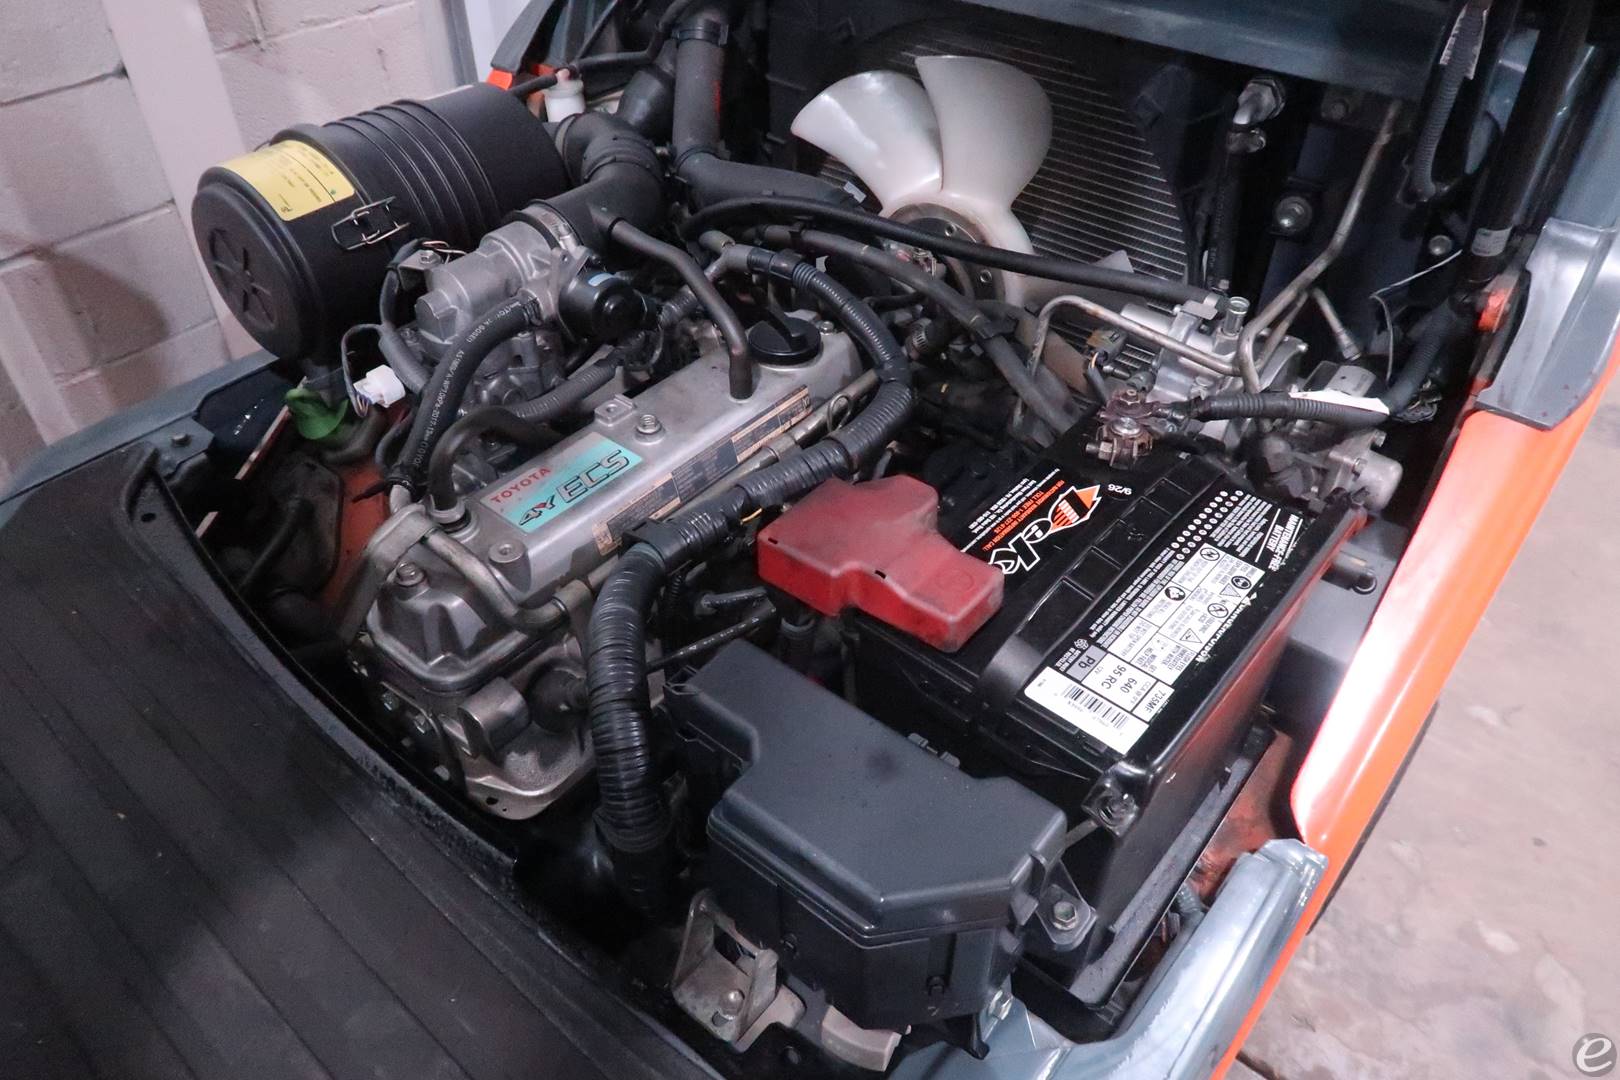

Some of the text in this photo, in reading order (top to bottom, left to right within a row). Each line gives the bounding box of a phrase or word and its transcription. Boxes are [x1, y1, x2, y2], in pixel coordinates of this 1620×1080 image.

[491, 467, 550, 503] TOYOTA
[518, 449, 631, 526] 4Y ECS
[1108, 484, 1132, 496] 9/26
[989, 484, 1102, 574] Dek
[1265, 524, 1284, 551] BATTERY
[1267, 514, 1298, 571] MAINTENANCE-FREE
[1076, 654, 1096, 670] Pb
[1100, 664, 1126, 689] 95 RC
[1118, 677, 1138, 693] 640
[1142, 689, 1165, 712] 735MF
